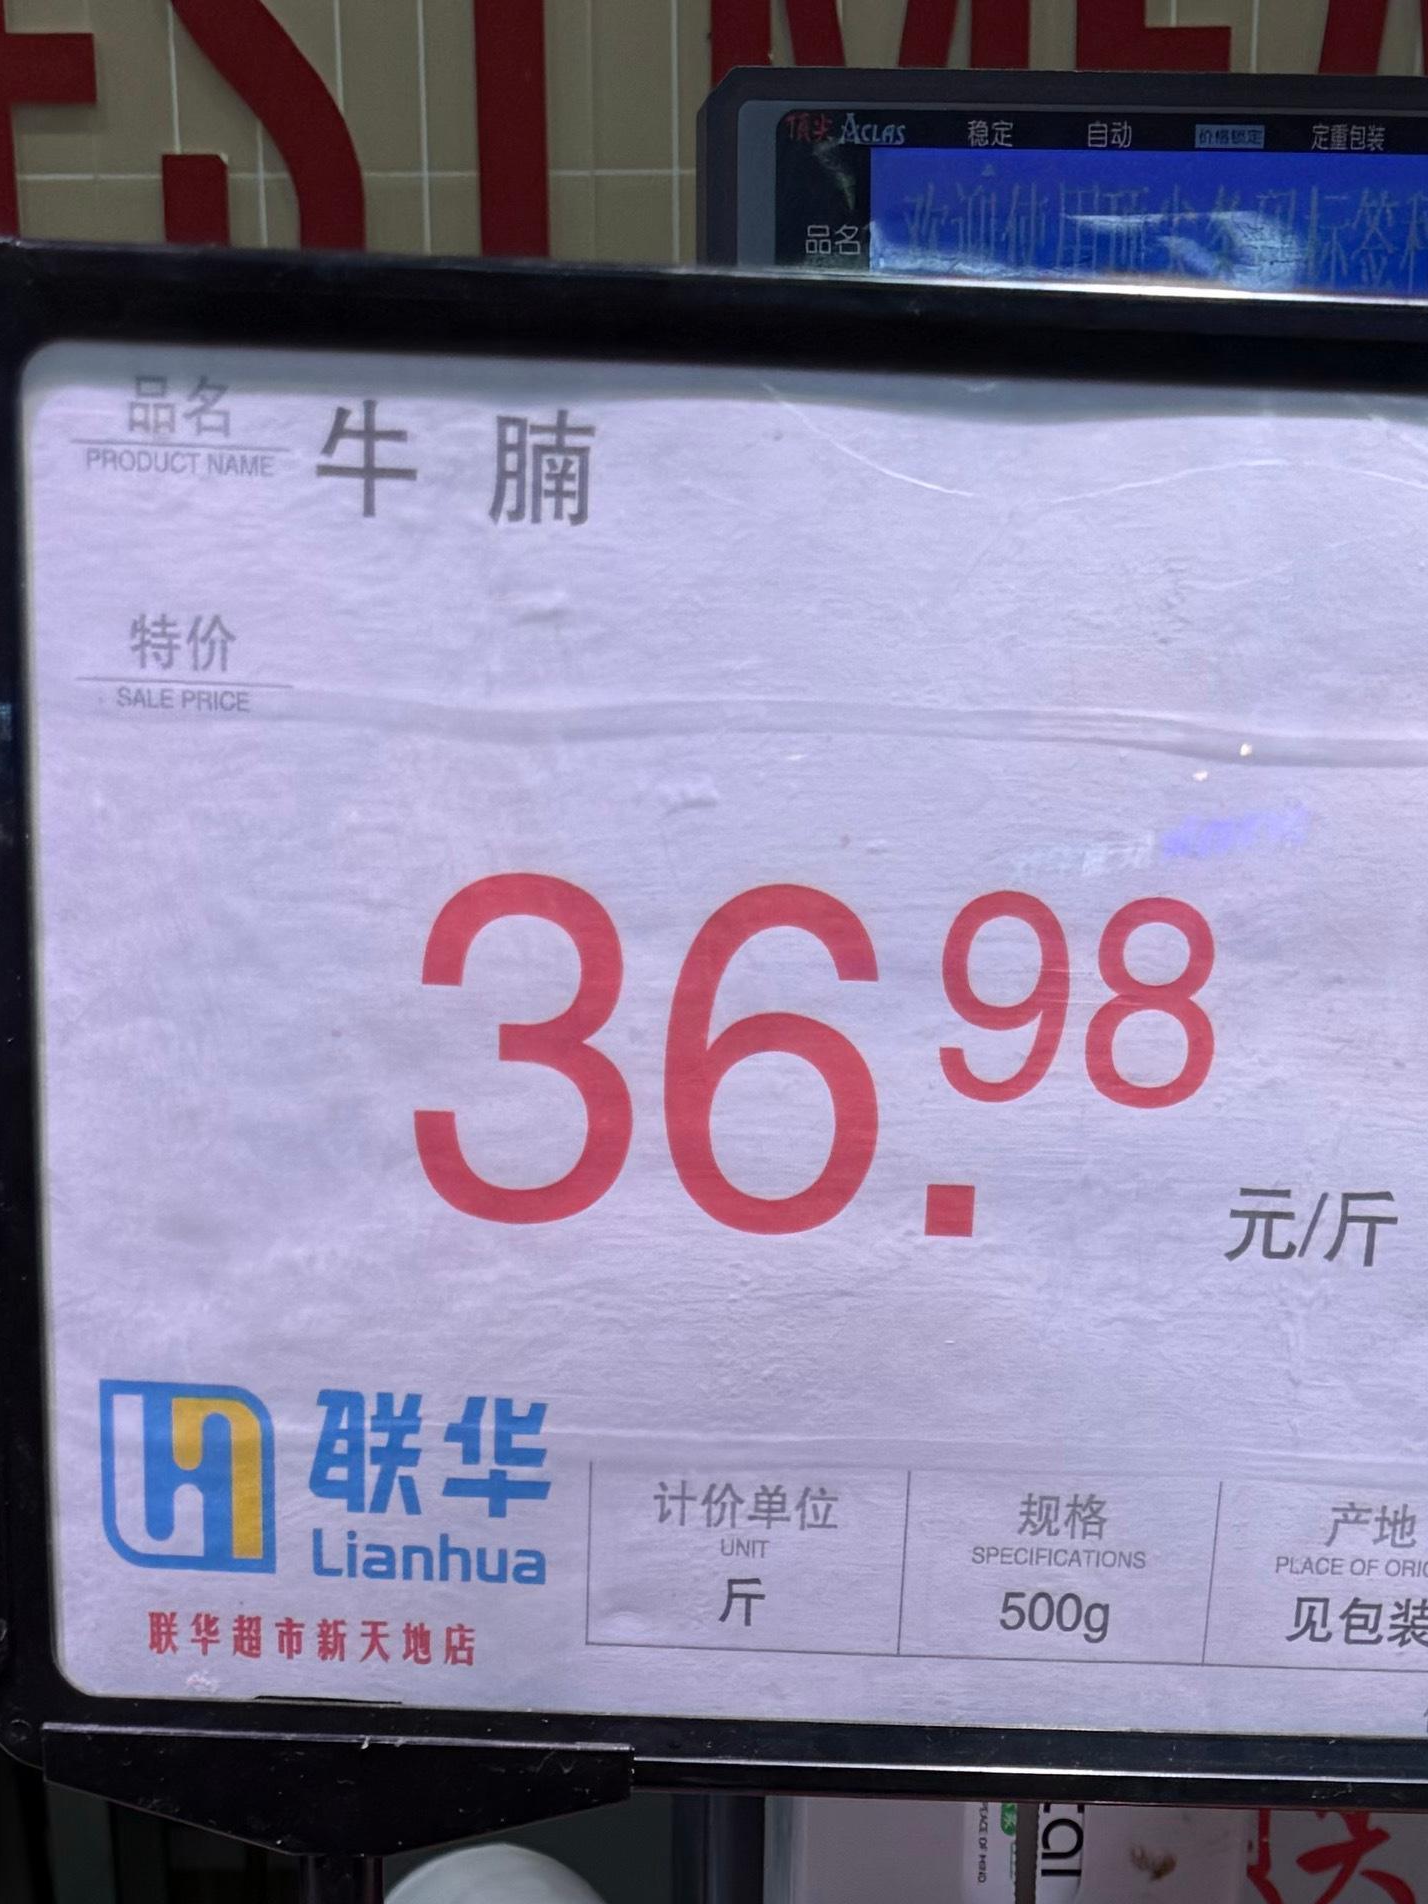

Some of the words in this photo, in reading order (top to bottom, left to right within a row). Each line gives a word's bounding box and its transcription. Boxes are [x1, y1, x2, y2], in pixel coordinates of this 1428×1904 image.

[967, 120, 1014, 148] 稳定
[1087, 121, 1132, 148] 自动
[1311, 123, 1386, 151] 定重包装
[805, 225, 861, 256] 品名
[127, 375, 232, 437] 品名
[86, 448, 201, 475] PRODUCT
[207, 452, 274, 477] NAME
[129, 612, 237, 672] 特价
[117, 687, 174, 710] SALE
[181, 690, 251, 712] PRICE
[1224, 1188, 1399, 1268] 元/斤
[309, 1388, 551, 1518] 联华
[653, 1480, 840, 1532] 计价单位
[1016, 1492, 1108, 1541] 规格
[1324, 1502, 1418, 1549] 产地
[312, 1528, 547, 1585] Lianhua
[720, 1538, 770, 1560] UNIT
[972, 1544, 1147, 1569] SPECIFICATIONS
[1275, 1557, 1344, 1576] PLACE
[1350, 1558, 1380, 1577] OF
[718, 1577, 766, 1627] 斤
[999, 1590, 1111, 1643] 500g
[148, 1610, 476, 1667] 联华超市新天地店
